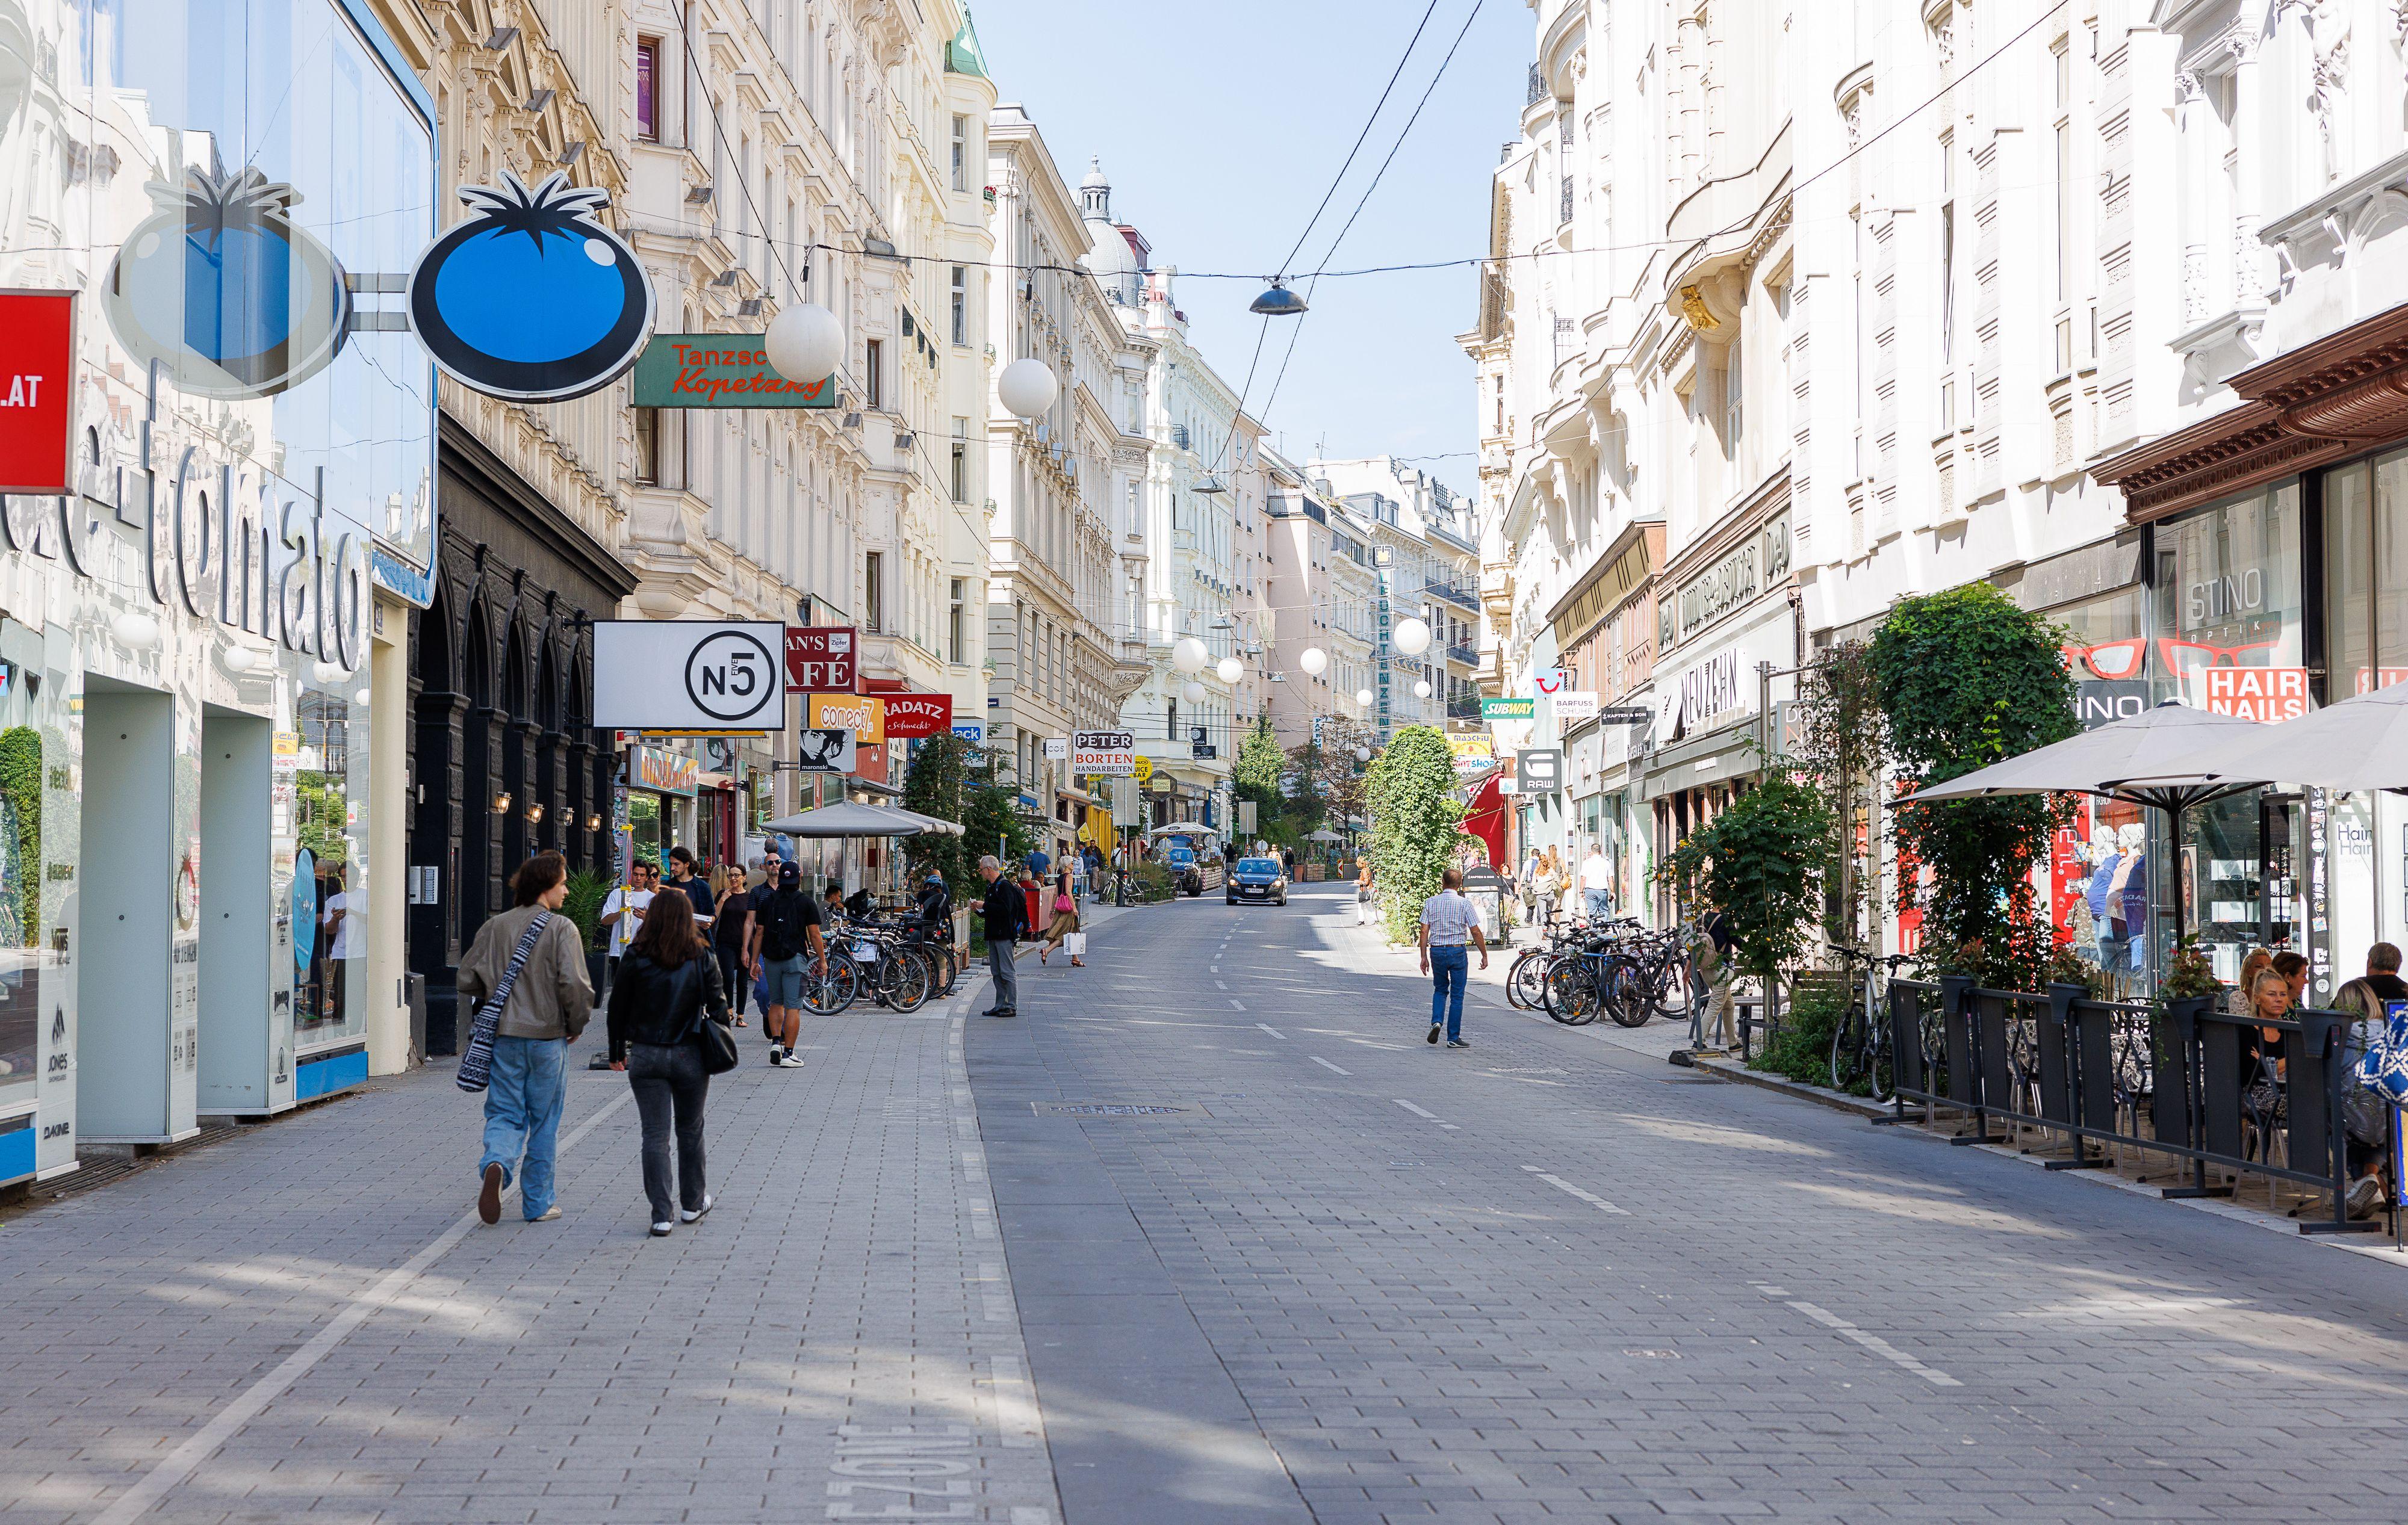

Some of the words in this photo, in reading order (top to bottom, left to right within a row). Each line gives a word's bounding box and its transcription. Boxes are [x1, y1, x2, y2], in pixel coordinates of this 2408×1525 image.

[671, 344, 771, 365] Tanzsc
[0, 375, 43, 407] .AT
[2191, 568, 2262, 621] STINO
[1379, 571, 1389, 743] LEUCHTENZENT
[2211, 671, 2303, 697] HAIR
[1485, 703, 1534, 715] SUBWAY
[2212, 699, 2303, 720] NAILS
[887, 721, 931, 730] Schmeckt
[1077, 735, 1132, 746] PETER
[1076, 753, 1132, 764] BORTEN
[1527, 780, 1554, 788] RAW
[2096, 797, 2111, 805] FASHION
[2338, 824, 2372, 840] Hair
[43, 1122, 70, 1140] DAKINE
